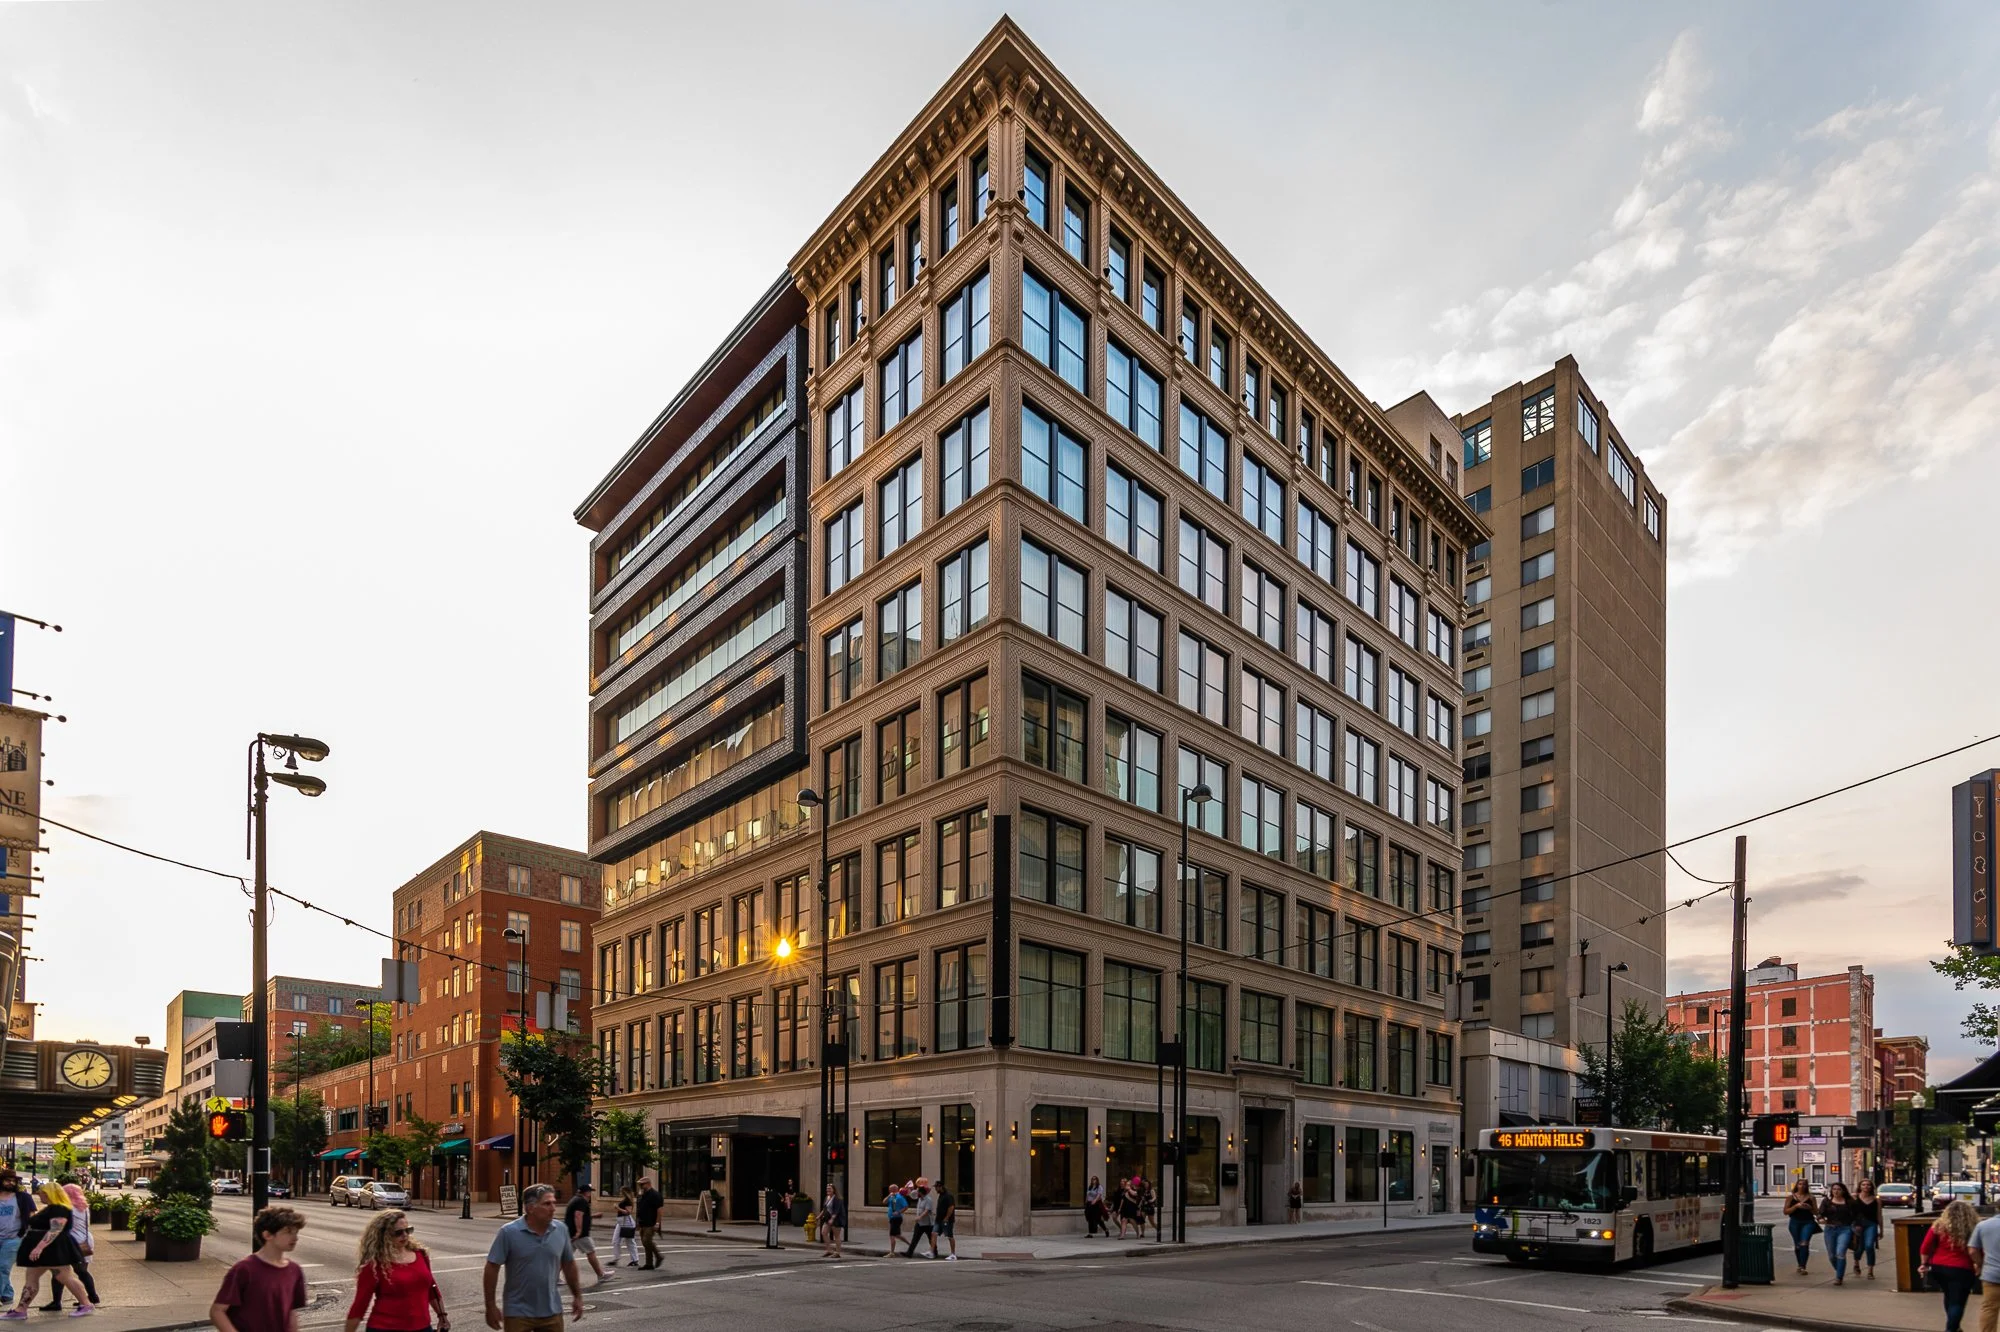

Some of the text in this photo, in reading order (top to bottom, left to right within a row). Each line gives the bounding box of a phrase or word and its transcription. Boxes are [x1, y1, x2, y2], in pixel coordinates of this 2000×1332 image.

[1498, 1133, 1584, 1147] 46 WINTON HILLS
[1775, 1124, 1787, 1142] 10
[1583, 1217, 1602, 1225] 1823
